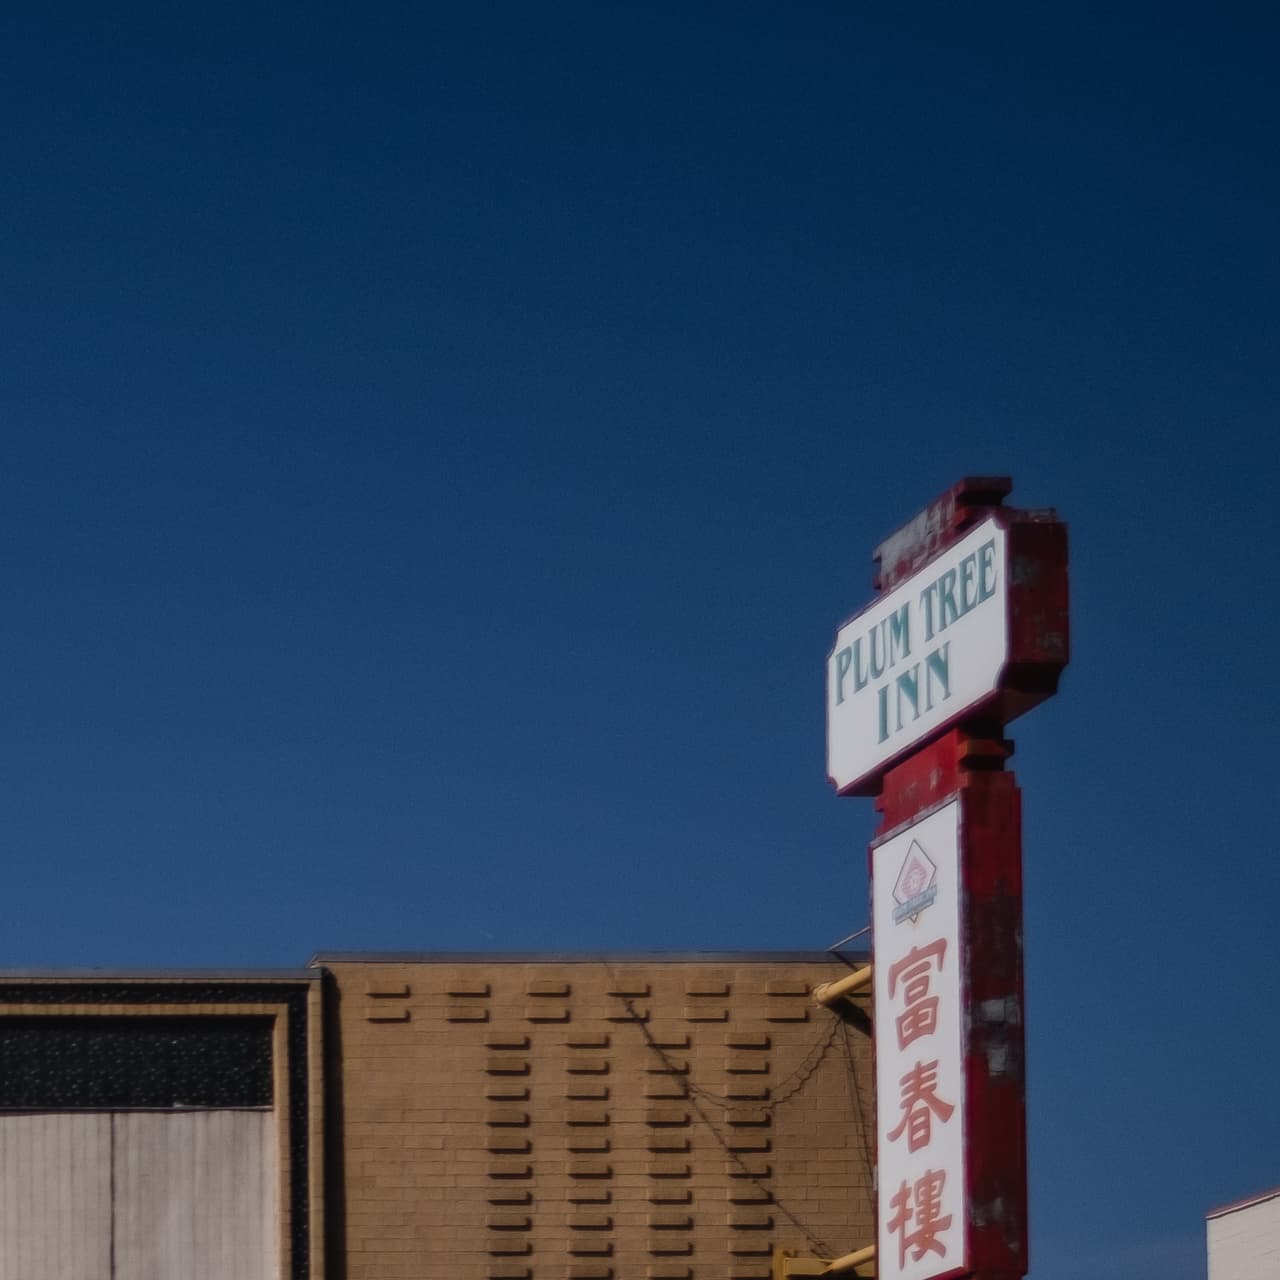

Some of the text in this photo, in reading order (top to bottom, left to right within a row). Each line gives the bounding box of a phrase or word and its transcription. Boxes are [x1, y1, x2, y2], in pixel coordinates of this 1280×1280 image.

[835, 537, 997, 706] PLUM TREE
[877, 640, 952, 744] INN
[886, 937, 955, 1271] 富春樓
